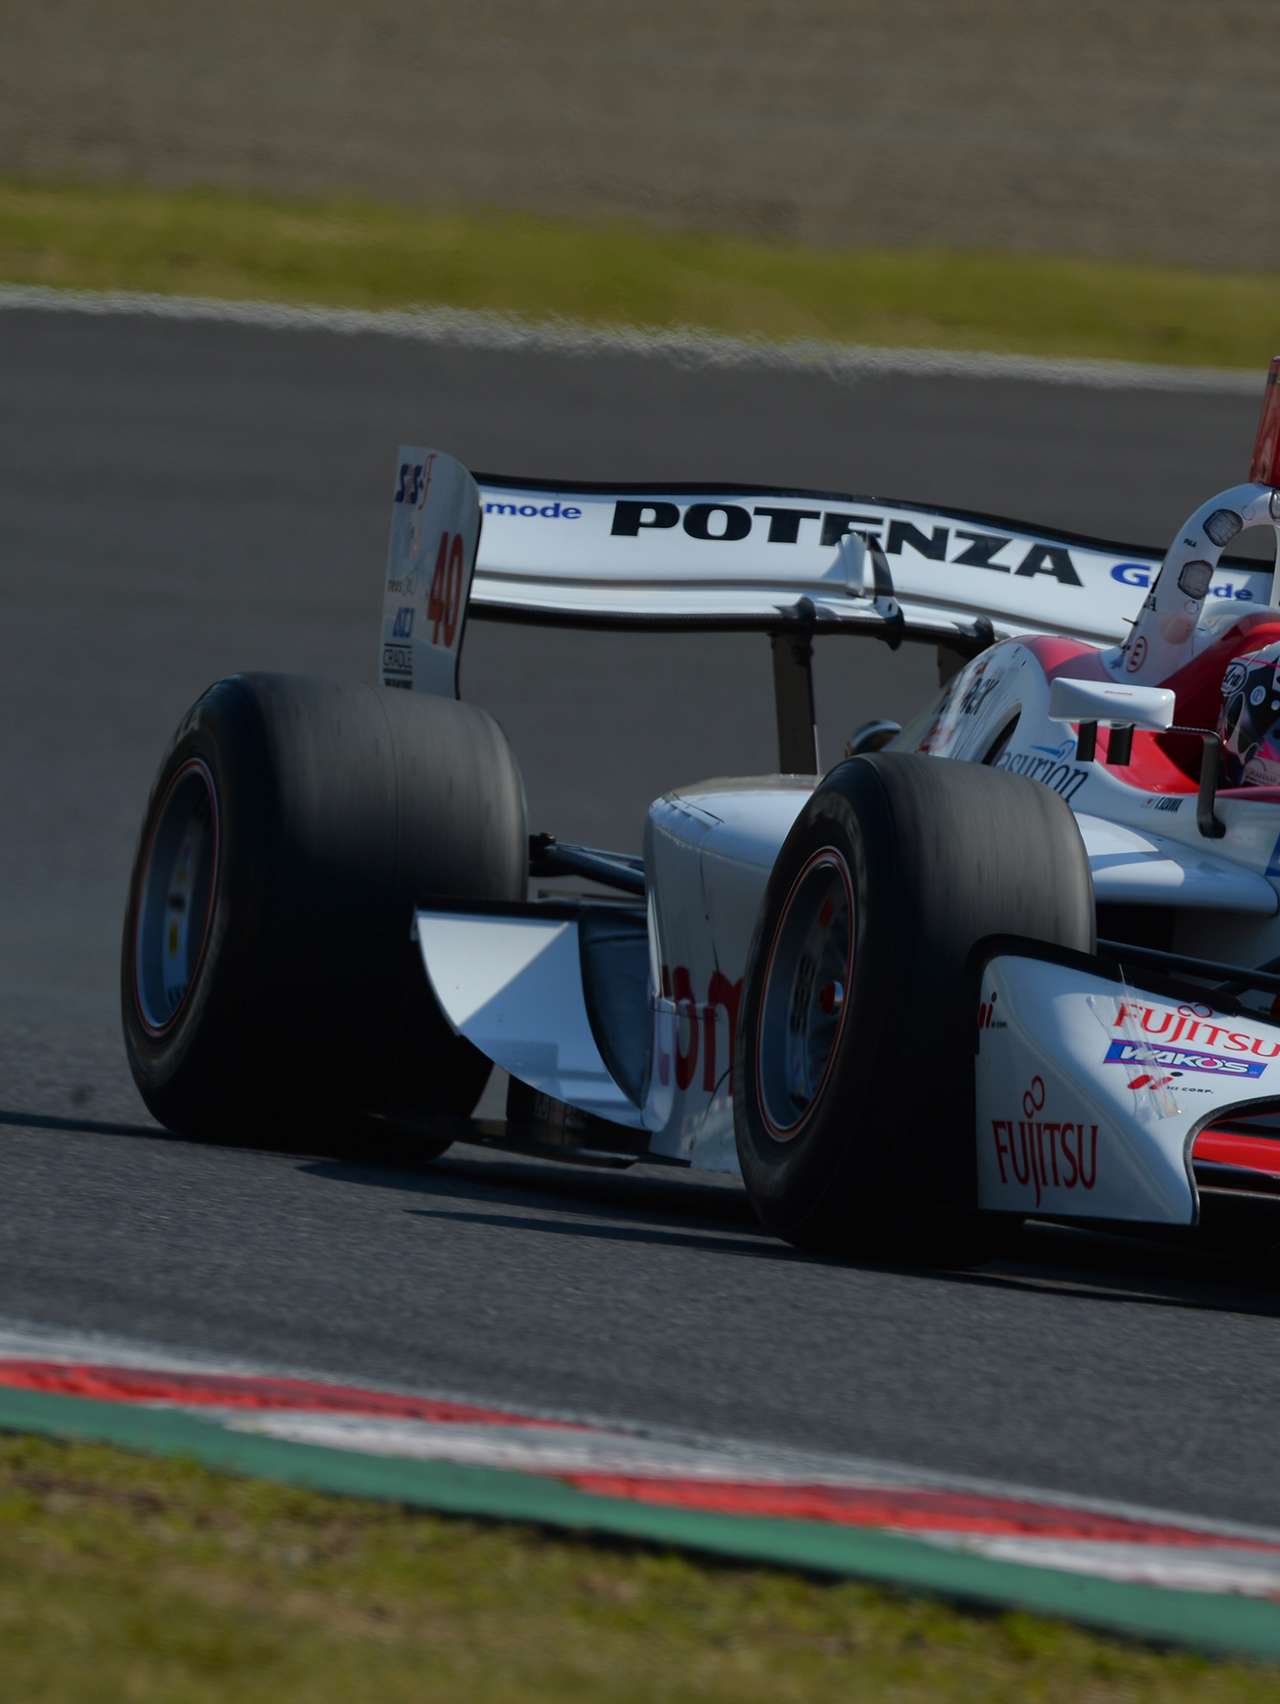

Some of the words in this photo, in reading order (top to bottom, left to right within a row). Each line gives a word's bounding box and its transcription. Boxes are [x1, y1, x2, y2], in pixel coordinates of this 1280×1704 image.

[611, 500, 1083, 587] POTENZA
[428, 532, 464, 648] 40
[1120, 1045, 1250, 1074] WAKO'S
[1181, 1086, 1214, 1094] CORP.
[992, 1120, 1099, 1209] FUJITSU
